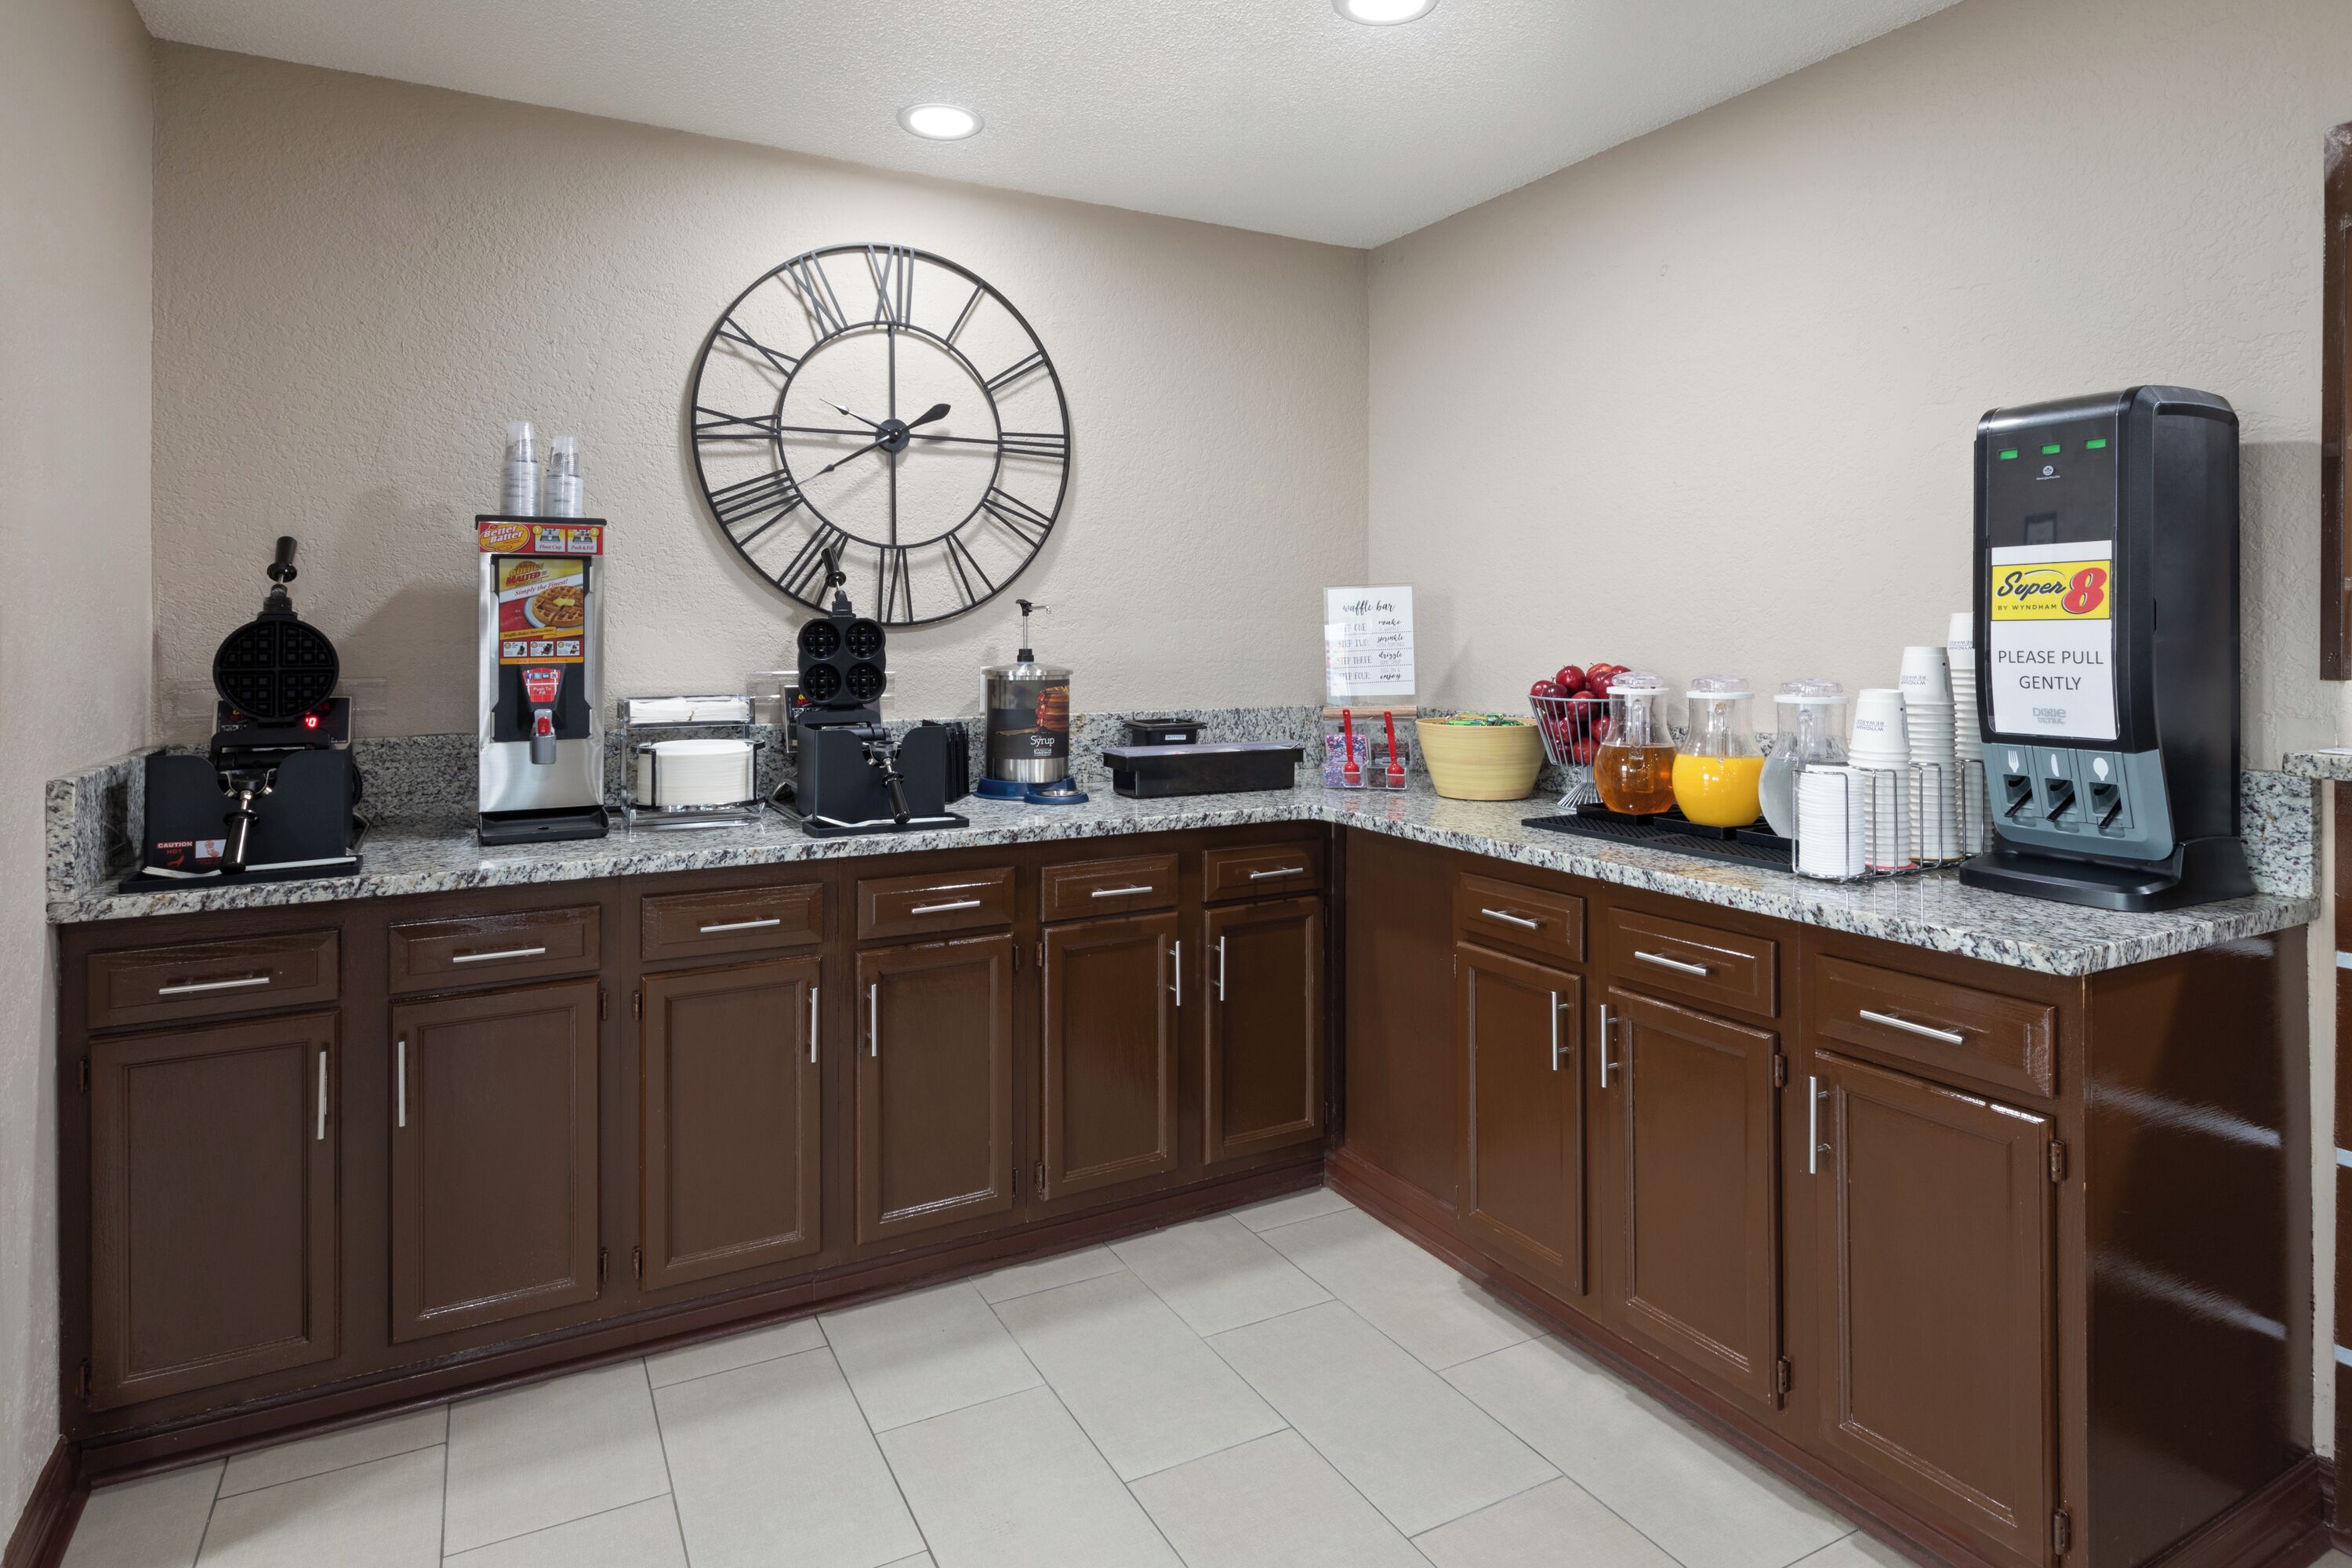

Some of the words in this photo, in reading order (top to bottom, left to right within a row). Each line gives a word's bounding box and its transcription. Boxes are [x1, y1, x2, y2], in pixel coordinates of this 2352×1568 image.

[483, 526, 517, 538] Better
[490, 531, 524, 543] Batter
[506, 571, 541, 586] MALTED
[514, 586, 535, 596] Simply
[548, 579, 568, 588] Finest!
[1997, 569, 2067, 601] Super
[2061, 567, 2107, 614] 8
[1343, 600, 1372, 616] waffle
[1376, 600, 1396, 612] bar
[1998, 650, 2056, 664] PLEASE
[2062, 651, 2104, 665] PULL
[2020, 676, 2082, 690] GENTLY
[1030, 735, 1055, 747] Syrup
